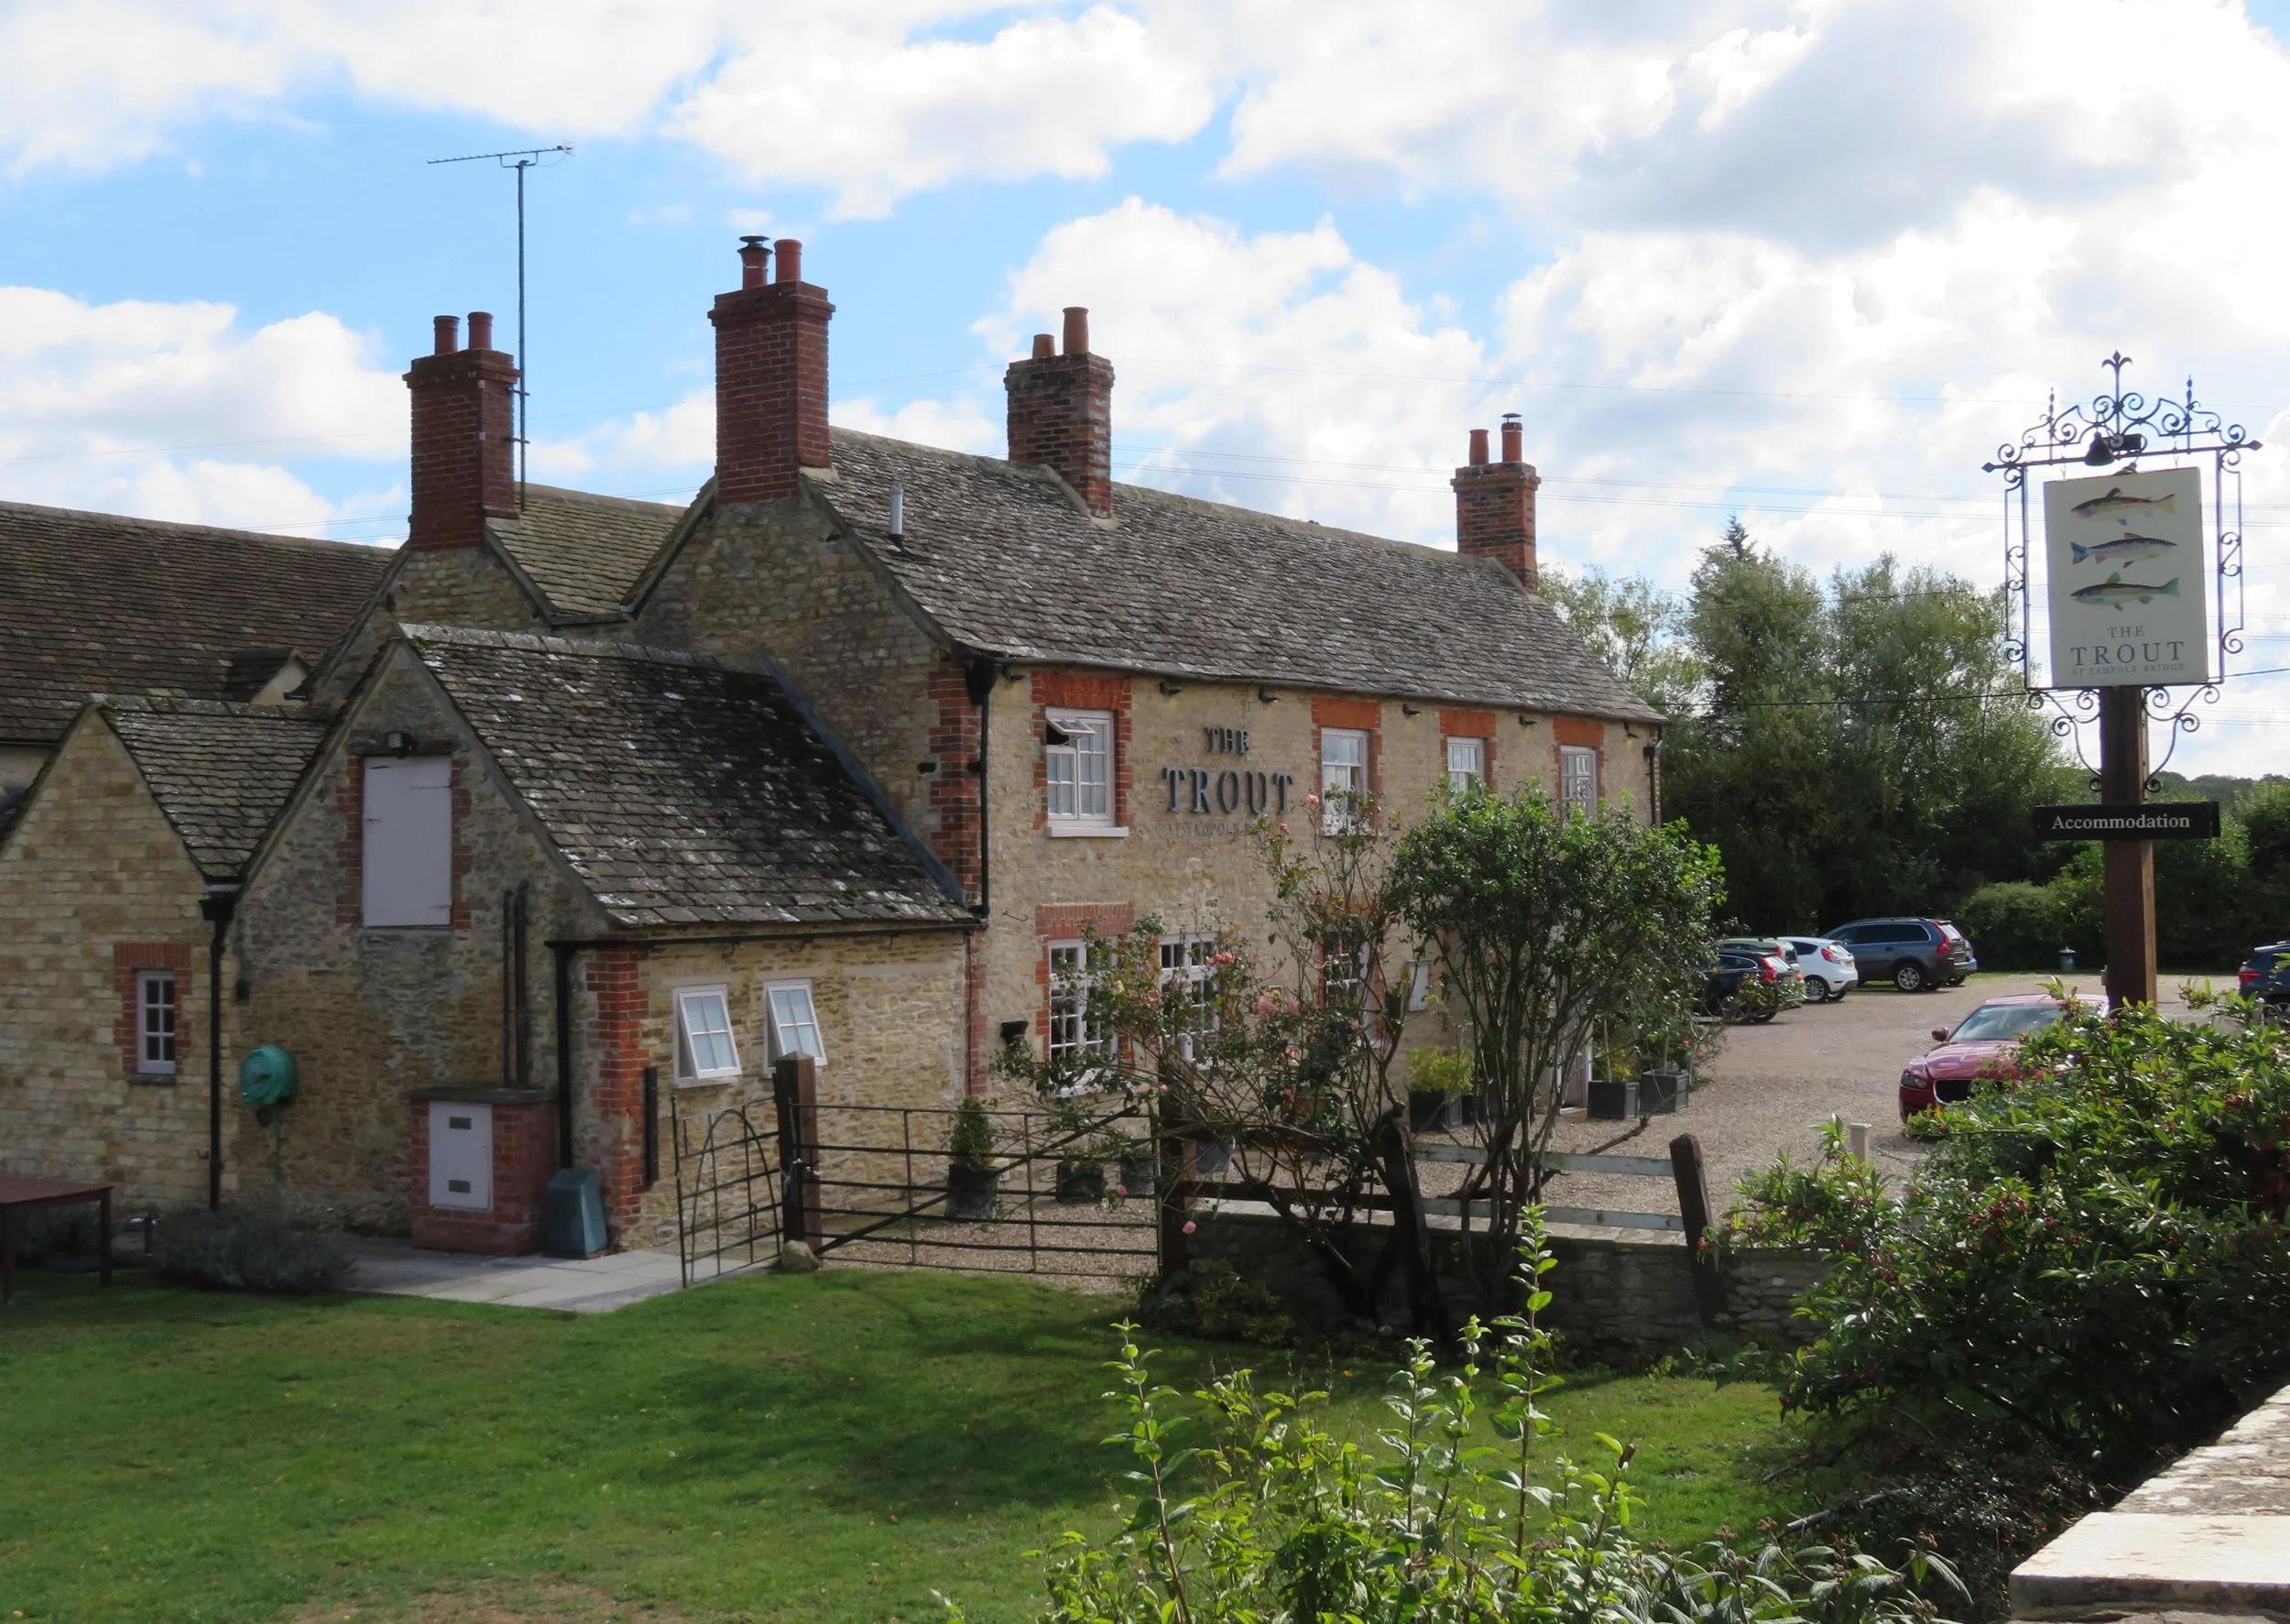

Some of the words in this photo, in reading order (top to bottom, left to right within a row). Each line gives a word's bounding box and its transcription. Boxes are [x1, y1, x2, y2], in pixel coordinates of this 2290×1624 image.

[2108, 626, 2144, 638] THE
[2070, 641, 2184, 666] TROUT
[2072, 668, 2085, 676] AT
[2089, 665, 2138, 675] TADPOLE
[2143, 663, 2185, 672] BRIDGE
[1205, 726, 1250, 754] THE
[1162, 767, 1293, 815] TROUT
[2052, 813, 2190, 830] Accommodation
